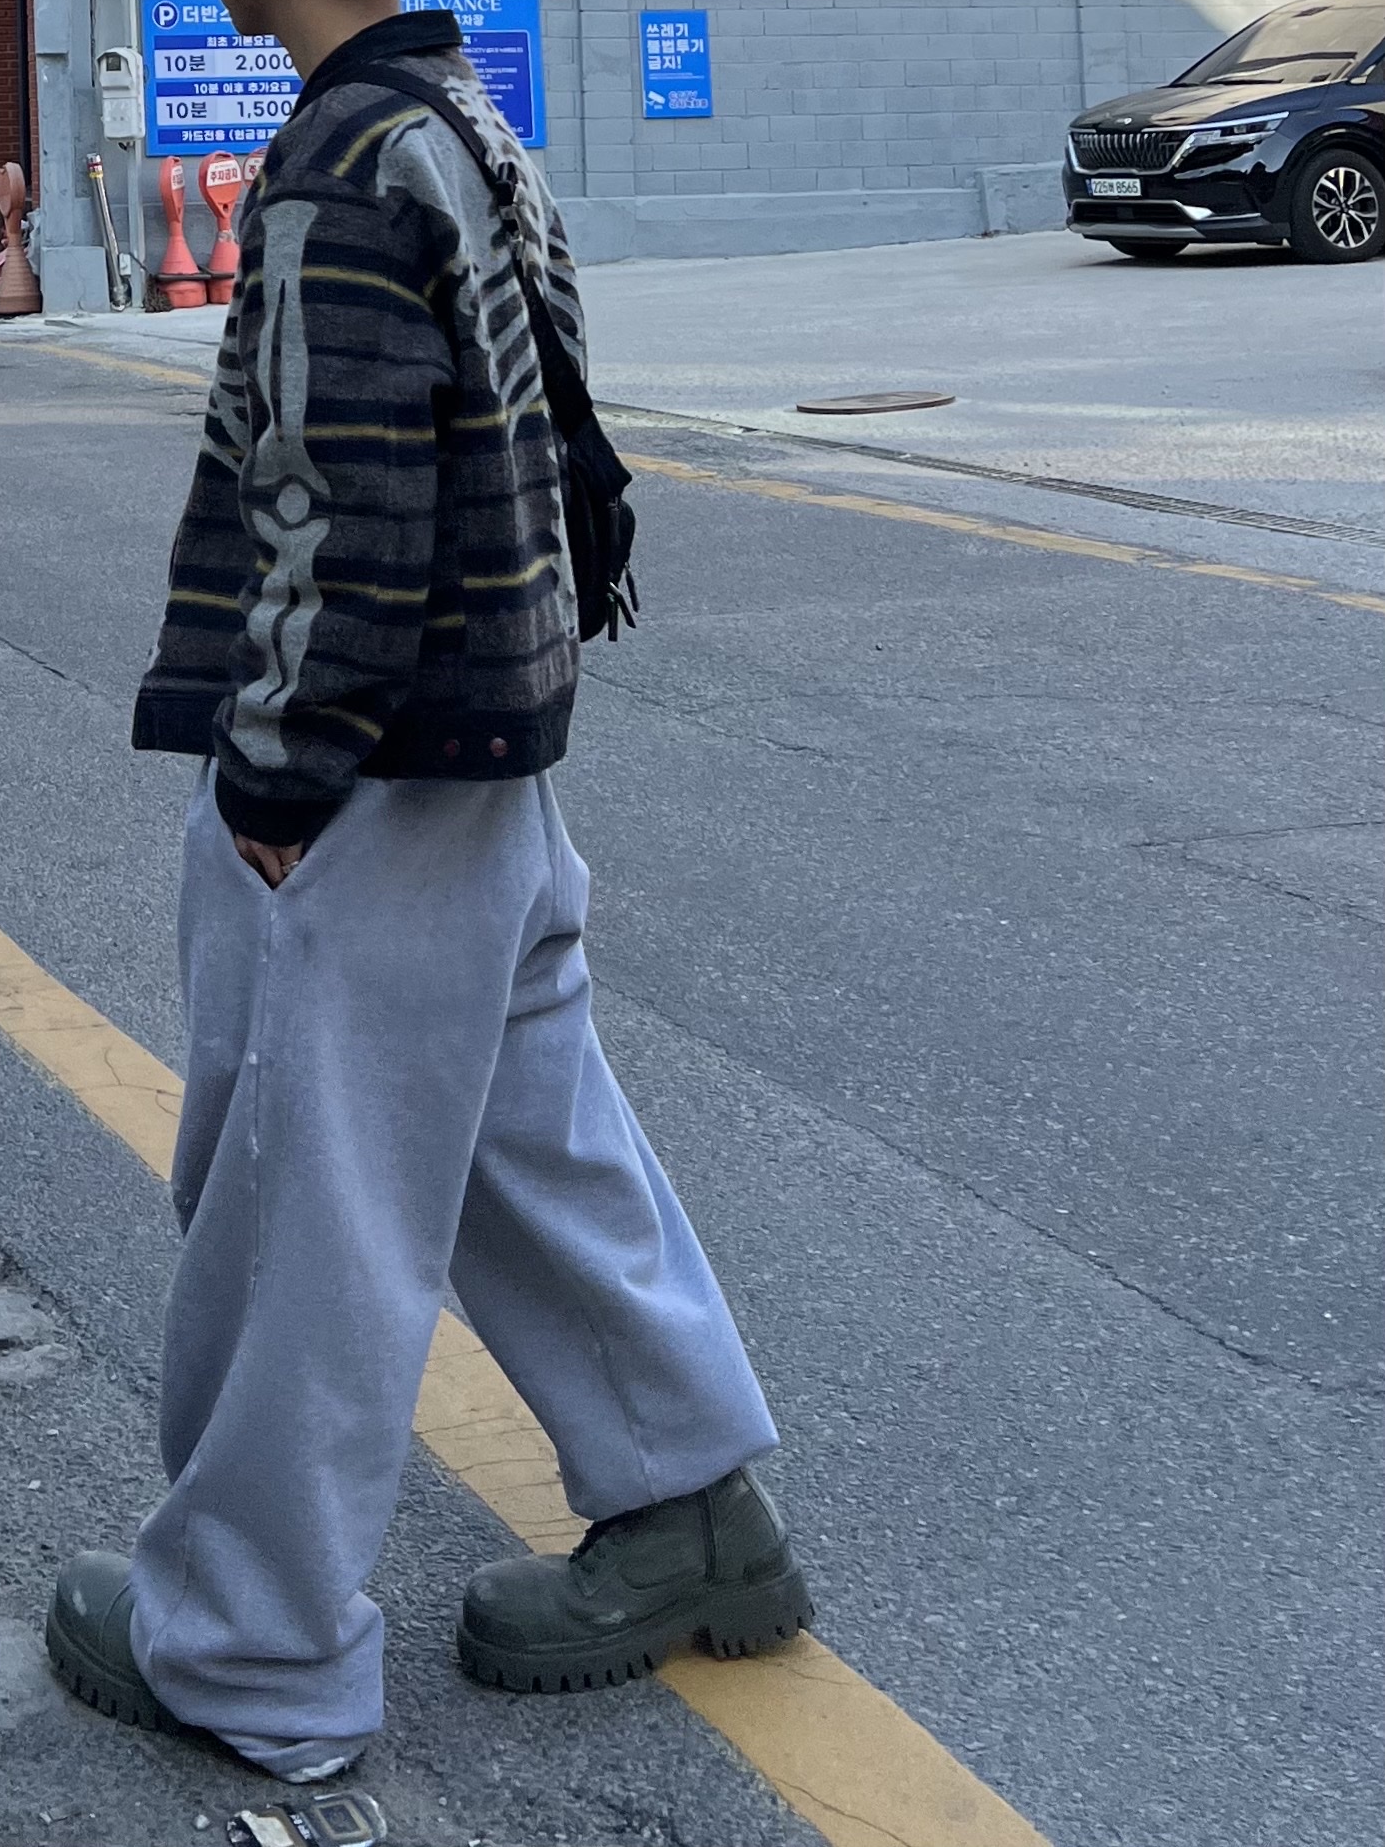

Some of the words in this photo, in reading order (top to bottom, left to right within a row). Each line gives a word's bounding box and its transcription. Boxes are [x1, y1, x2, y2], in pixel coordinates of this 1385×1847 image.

[646, 23, 689, 38] 쓰레기
[206, 36, 229, 47] 최초
[232, 35, 276, 47] 기본요금
[647, 39, 705, 54] 불법투기
[164, 55, 206, 72] 10분
[235, 54, 294, 72] 2,000
[648, 55, 682, 70] 금지!
[193, 83, 220, 94] 10분
[223, 82, 245, 94] 이후
[248, 82, 292, 94] 추가요금
[166, 101, 208, 119] 10분
[237, 101, 293, 119] 1,500
[182, 130, 226, 142] 카드전용
